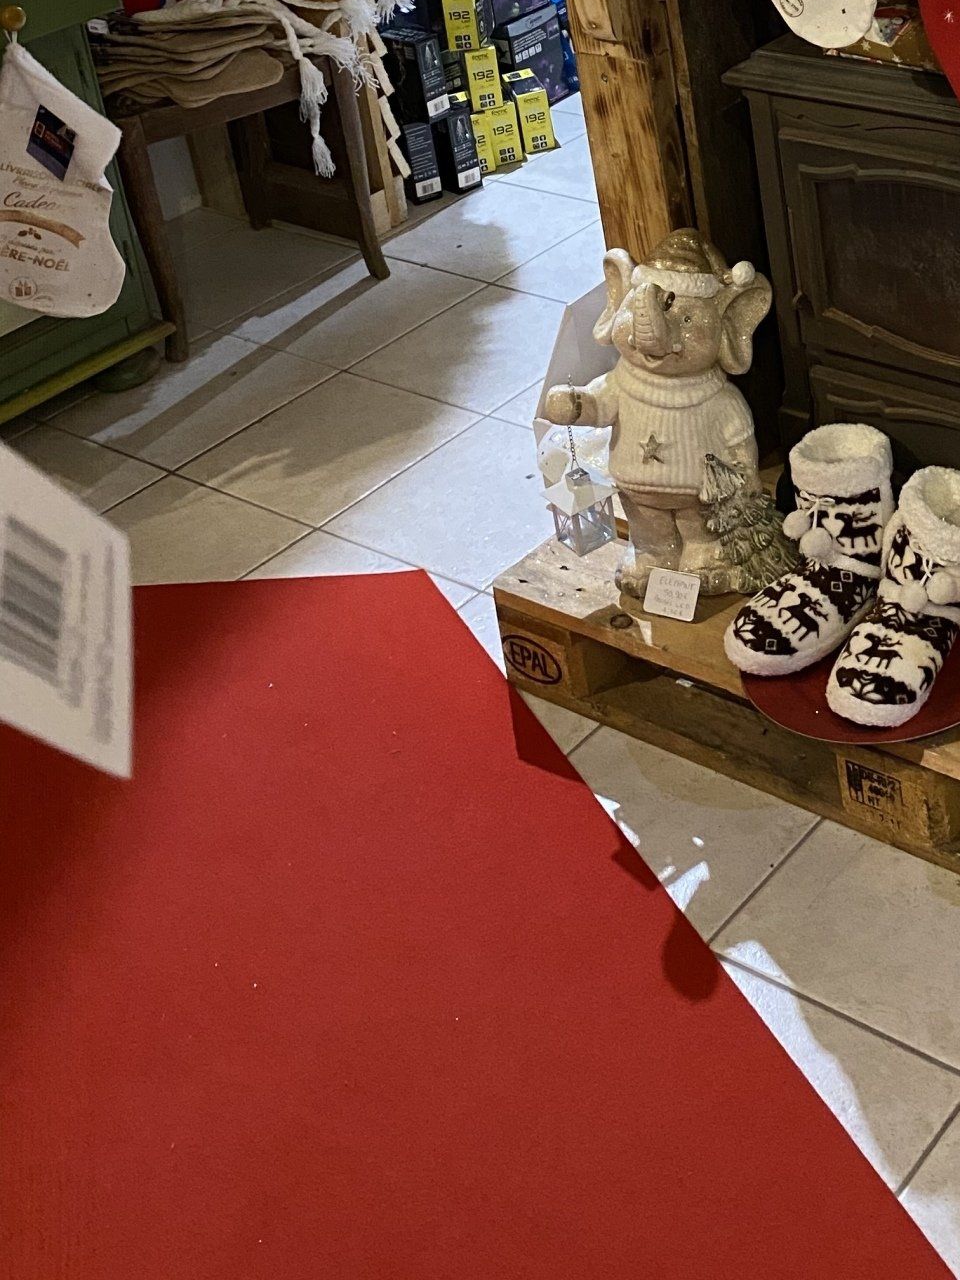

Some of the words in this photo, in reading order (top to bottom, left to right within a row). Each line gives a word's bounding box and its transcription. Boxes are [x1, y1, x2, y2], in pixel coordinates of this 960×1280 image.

[448, 10, 471, 21] 192
[472, 69, 495, 82] 192
[524, 111, 546, 124] 192
[492, 123, 514, 136] 192
[509, 640, 555, 679] EPAL
